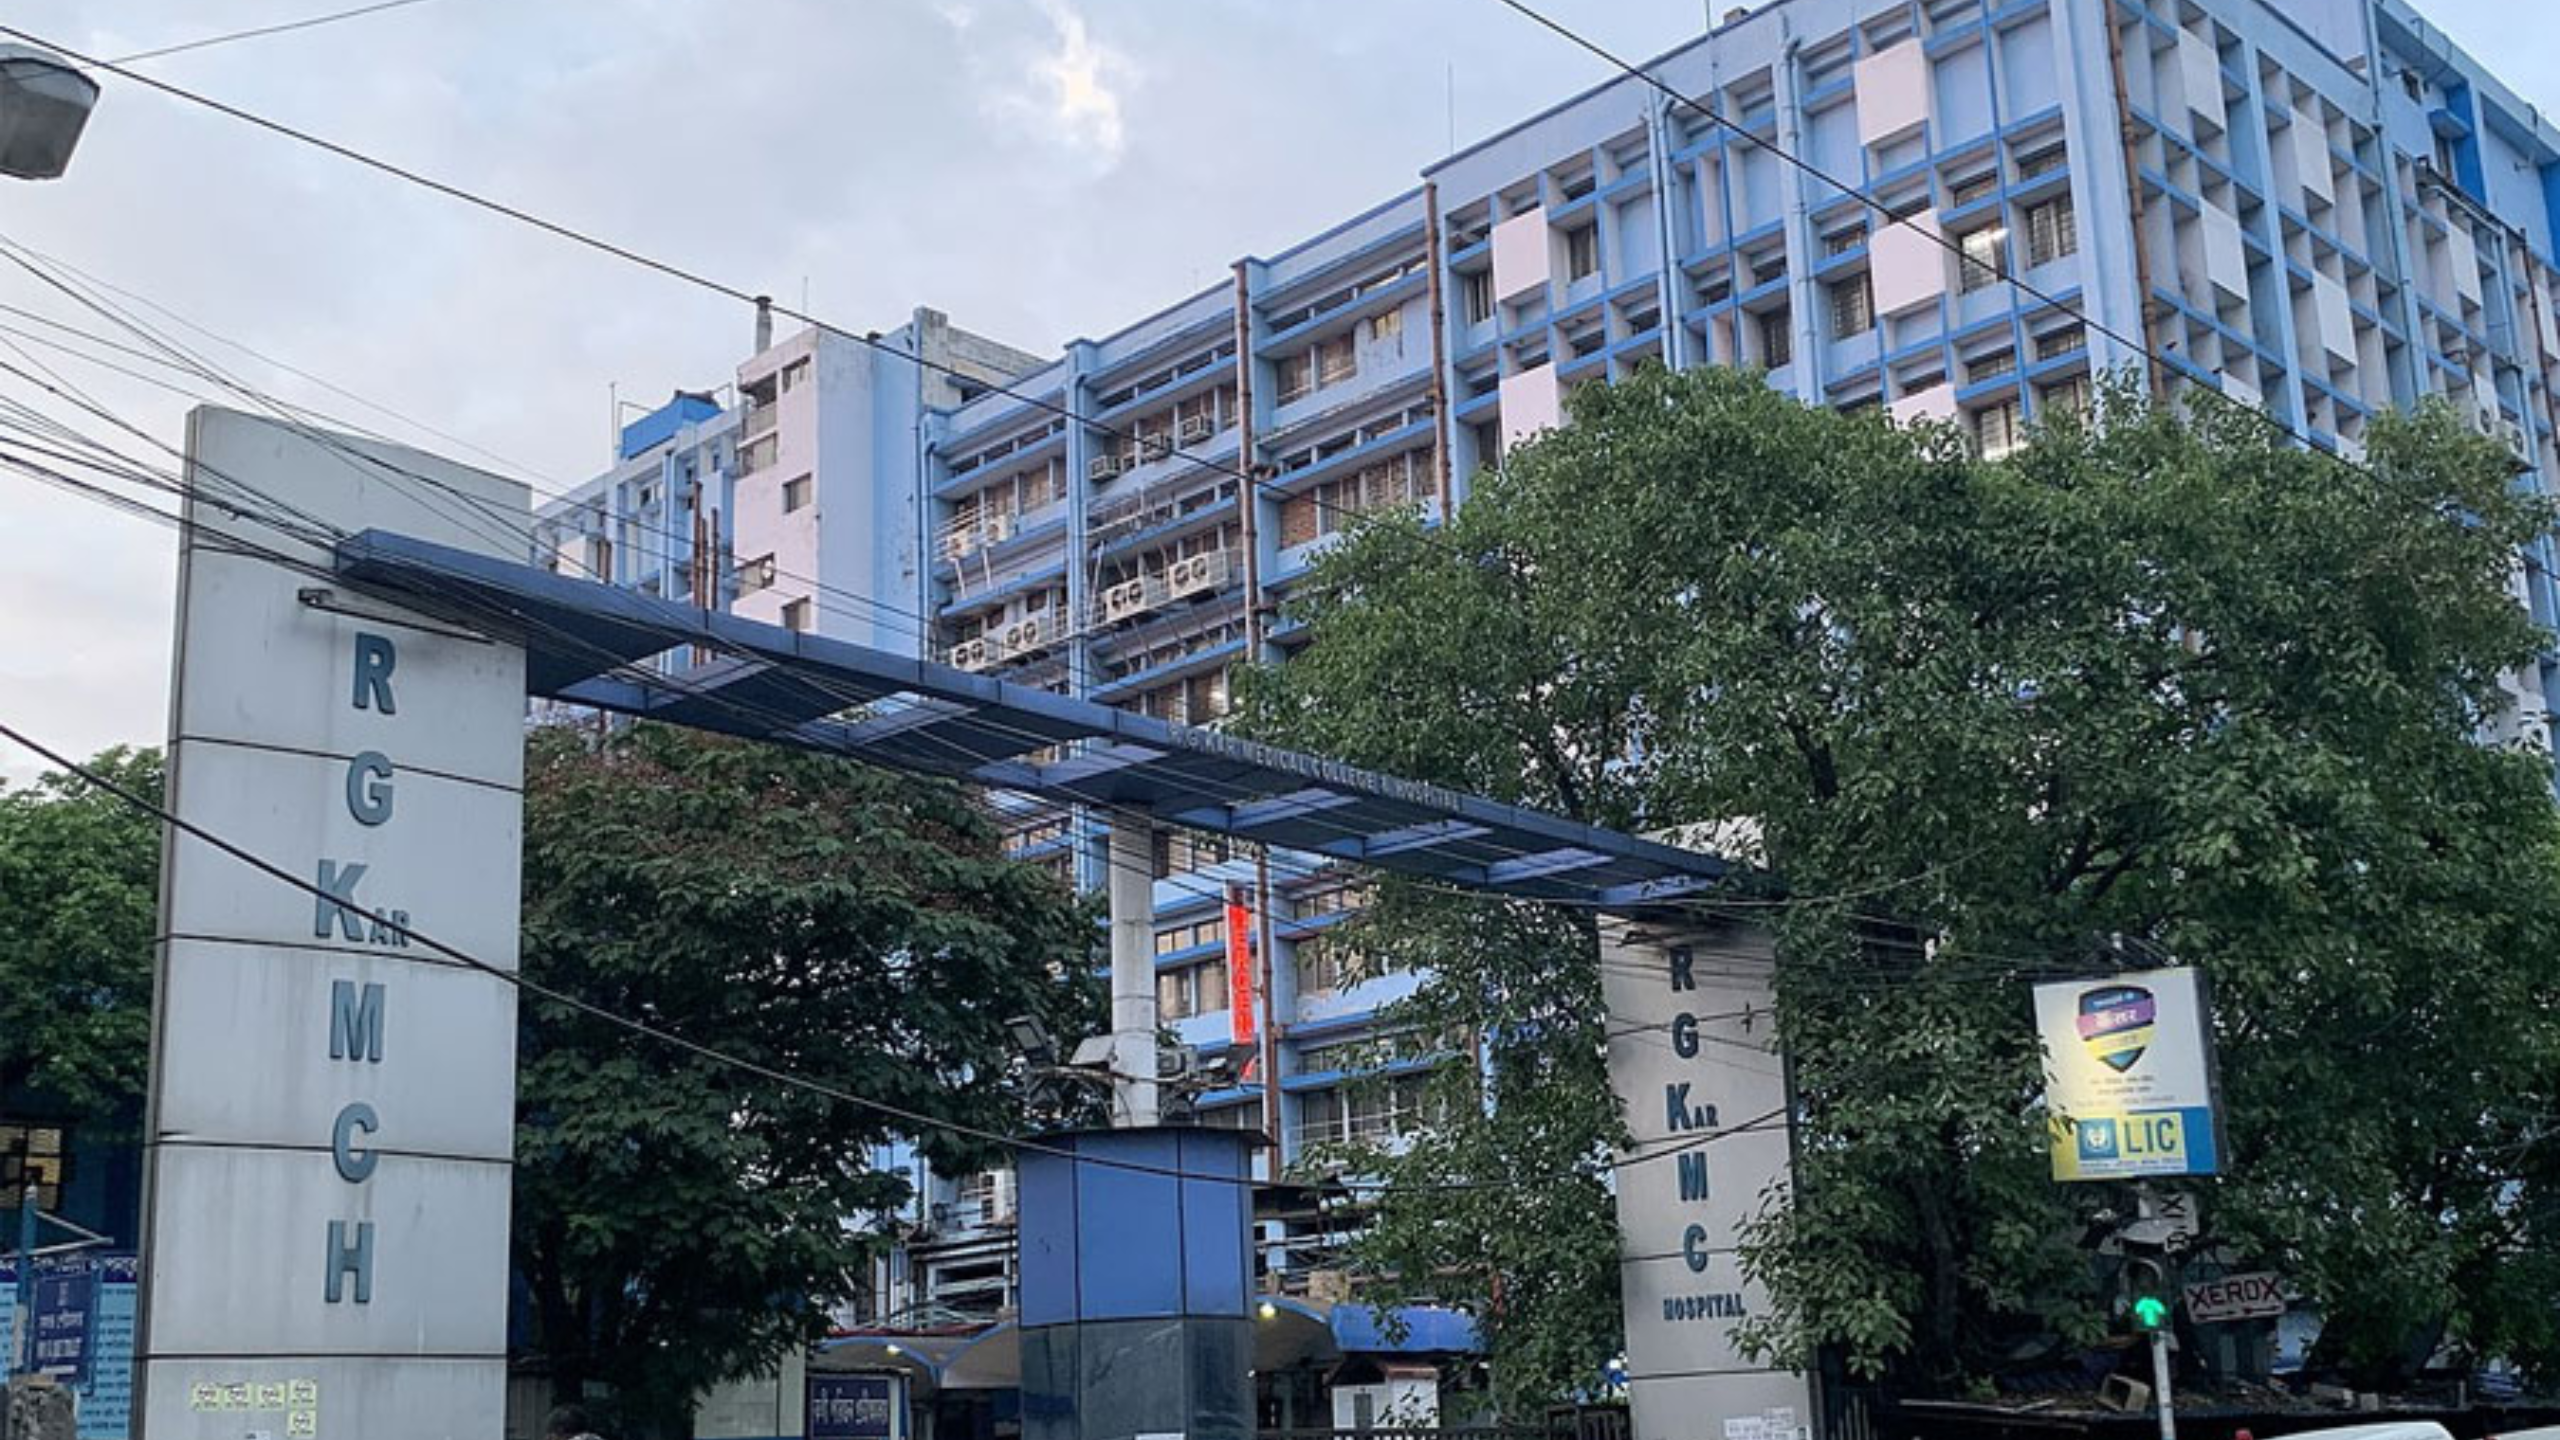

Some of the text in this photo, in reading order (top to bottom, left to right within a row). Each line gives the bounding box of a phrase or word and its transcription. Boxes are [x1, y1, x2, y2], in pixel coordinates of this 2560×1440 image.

[352, 631, 396, 715] R
[347, 751, 393, 826] G
[1670, 944, 1696, 991] R
[330, 980, 385, 1063] M
[1672, 1012, 1699, 1060] G
[332, 1102, 379, 1183] C
[2123, 1118, 2176, 1153] LIC
[1678, 1152, 1708, 1202] M
[324, 1220, 374, 1303] H
[1683, 1223, 1708, 1273] C
[1663, 1293, 1746, 1321] HOSPITAL
[2187, 1276, 2283, 1311] XEROX
